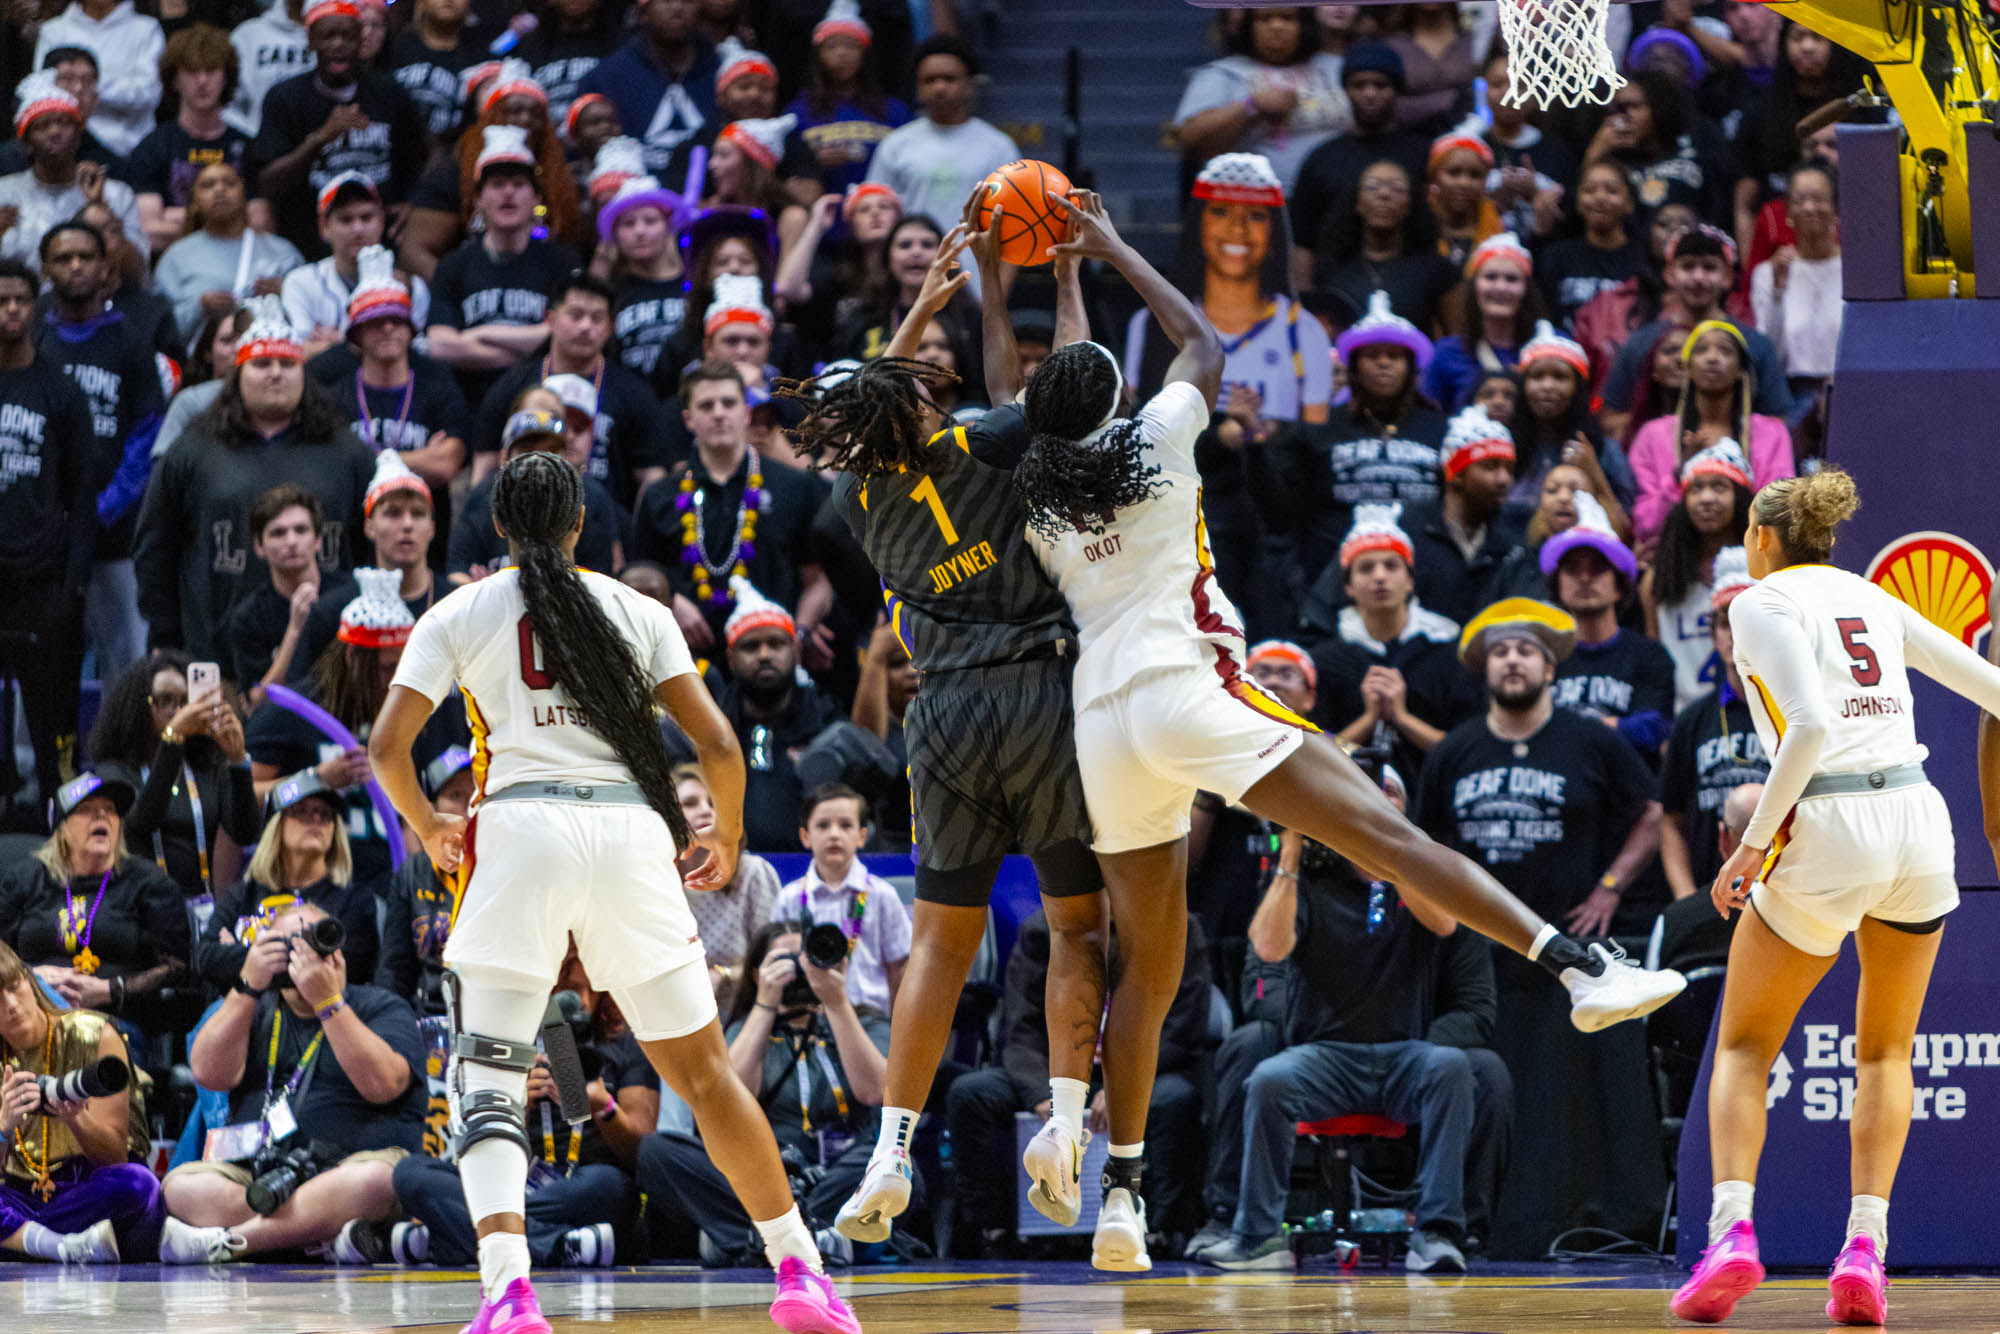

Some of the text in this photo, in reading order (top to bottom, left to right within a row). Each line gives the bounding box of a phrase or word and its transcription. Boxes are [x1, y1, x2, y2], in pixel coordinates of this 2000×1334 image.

[908, 474, 960, 547] 1
[212, 519, 343, 574] LU
[928, 540, 998, 594] JOYNER
[1083, 533, 1122, 562] OKOT
[1678, 612, 1716, 641] LS
[1834, 617, 1882, 687] 5
[533, 704, 593, 728] LATSO
[1697, 732, 1744, 777] DEAF
[1454, 766, 1567, 808] DEAF DOME
[1803, 1024, 2000, 1077] Eipm
[1803, 1077, 1967, 1120] Sre
